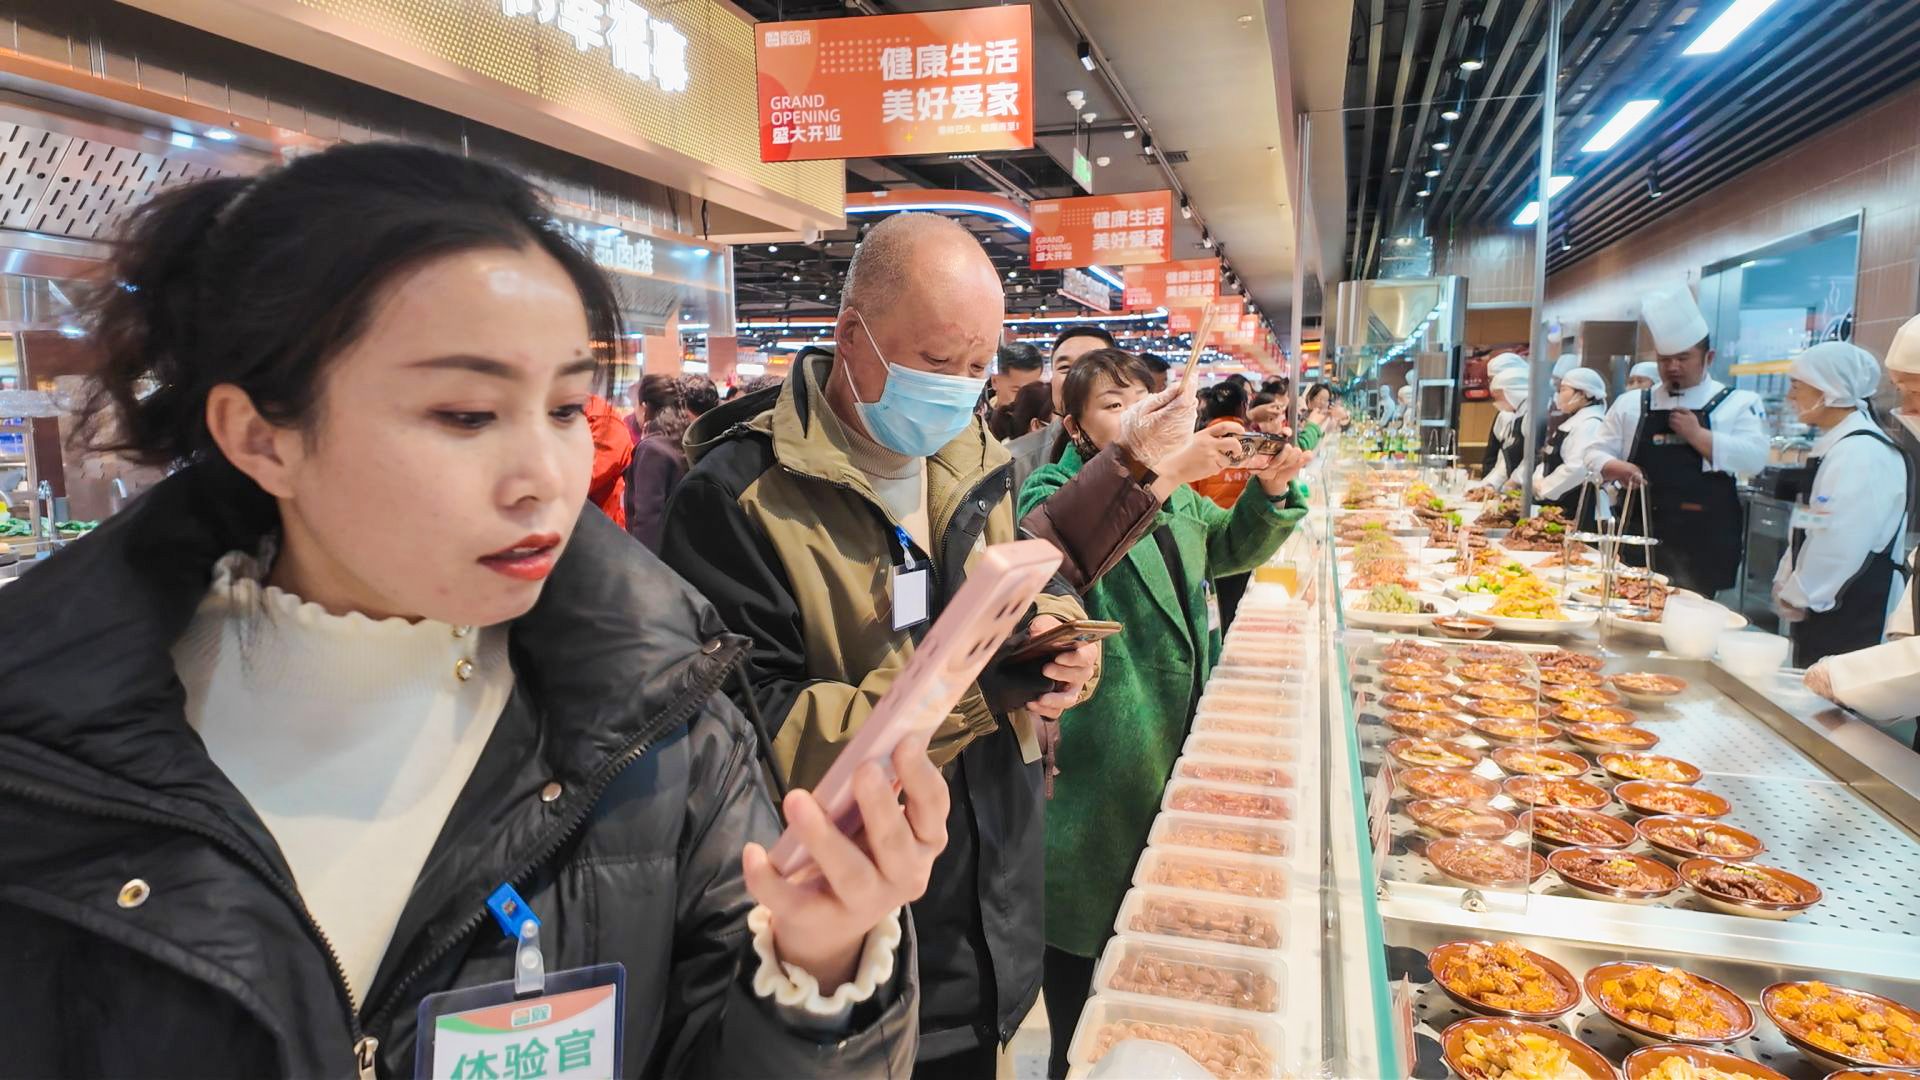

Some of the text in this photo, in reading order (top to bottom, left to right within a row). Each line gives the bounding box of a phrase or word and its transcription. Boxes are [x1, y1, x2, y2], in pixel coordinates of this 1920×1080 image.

[881, 38, 1018, 81] 健康生活
[770, 94, 825, 110] GRAND
[882, 82, 1020, 123] 美好爱家
[771, 109, 841, 126] OPENING
[772, 125, 842, 145] 盛大开业
[1092, 207, 1165, 230] 健康生活
[1036, 235, 1065, 245] GRAND
[1036, 243, 1073, 253] OPENING
[1092, 228, 1165, 251] 美好爱家
[1036, 252, 1073, 262] 盛大开业
[450, 1028, 596, 1080] 体验官
